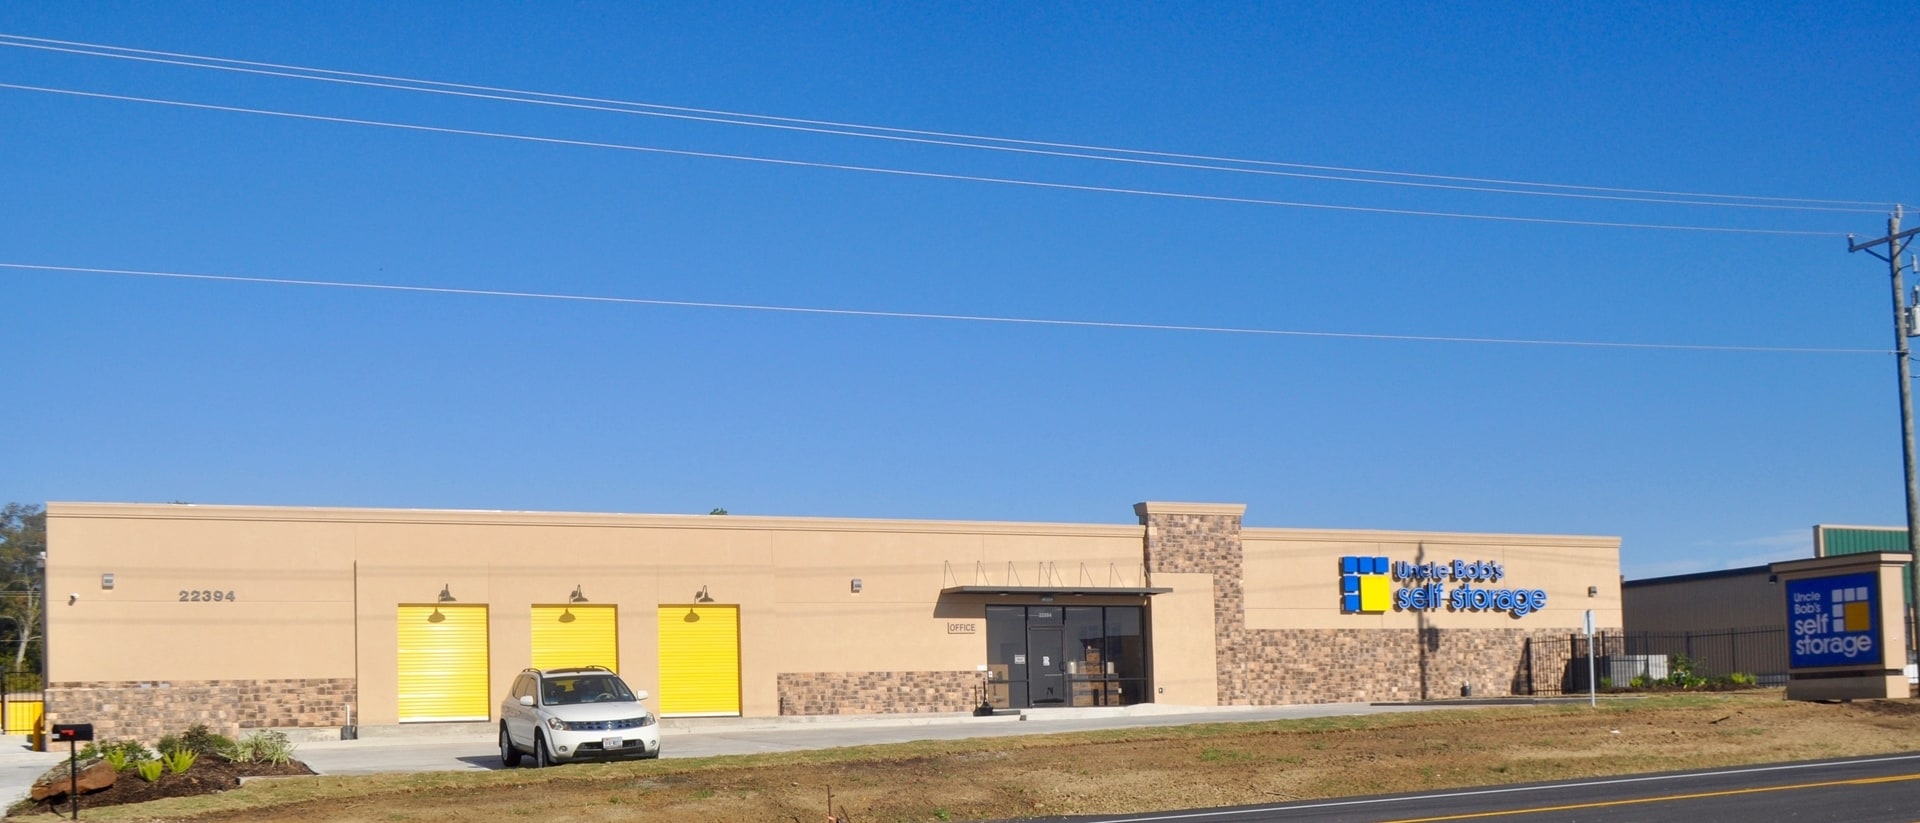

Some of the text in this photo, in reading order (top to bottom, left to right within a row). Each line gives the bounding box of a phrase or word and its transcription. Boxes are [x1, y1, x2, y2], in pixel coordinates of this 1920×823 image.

[1396, 559, 1504, 579] Uncle Bob's
[179, 590, 236, 602] 22394
[1398, 583, 1547, 616] self storage
[1794, 592, 1821, 602] Uncle
[1794, 603, 1821, 614] Bob's
[949, 623, 976, 632] OFFICE
[1795, 613, 1829, 635] self
[1796, 635, 1872, 657] storage
